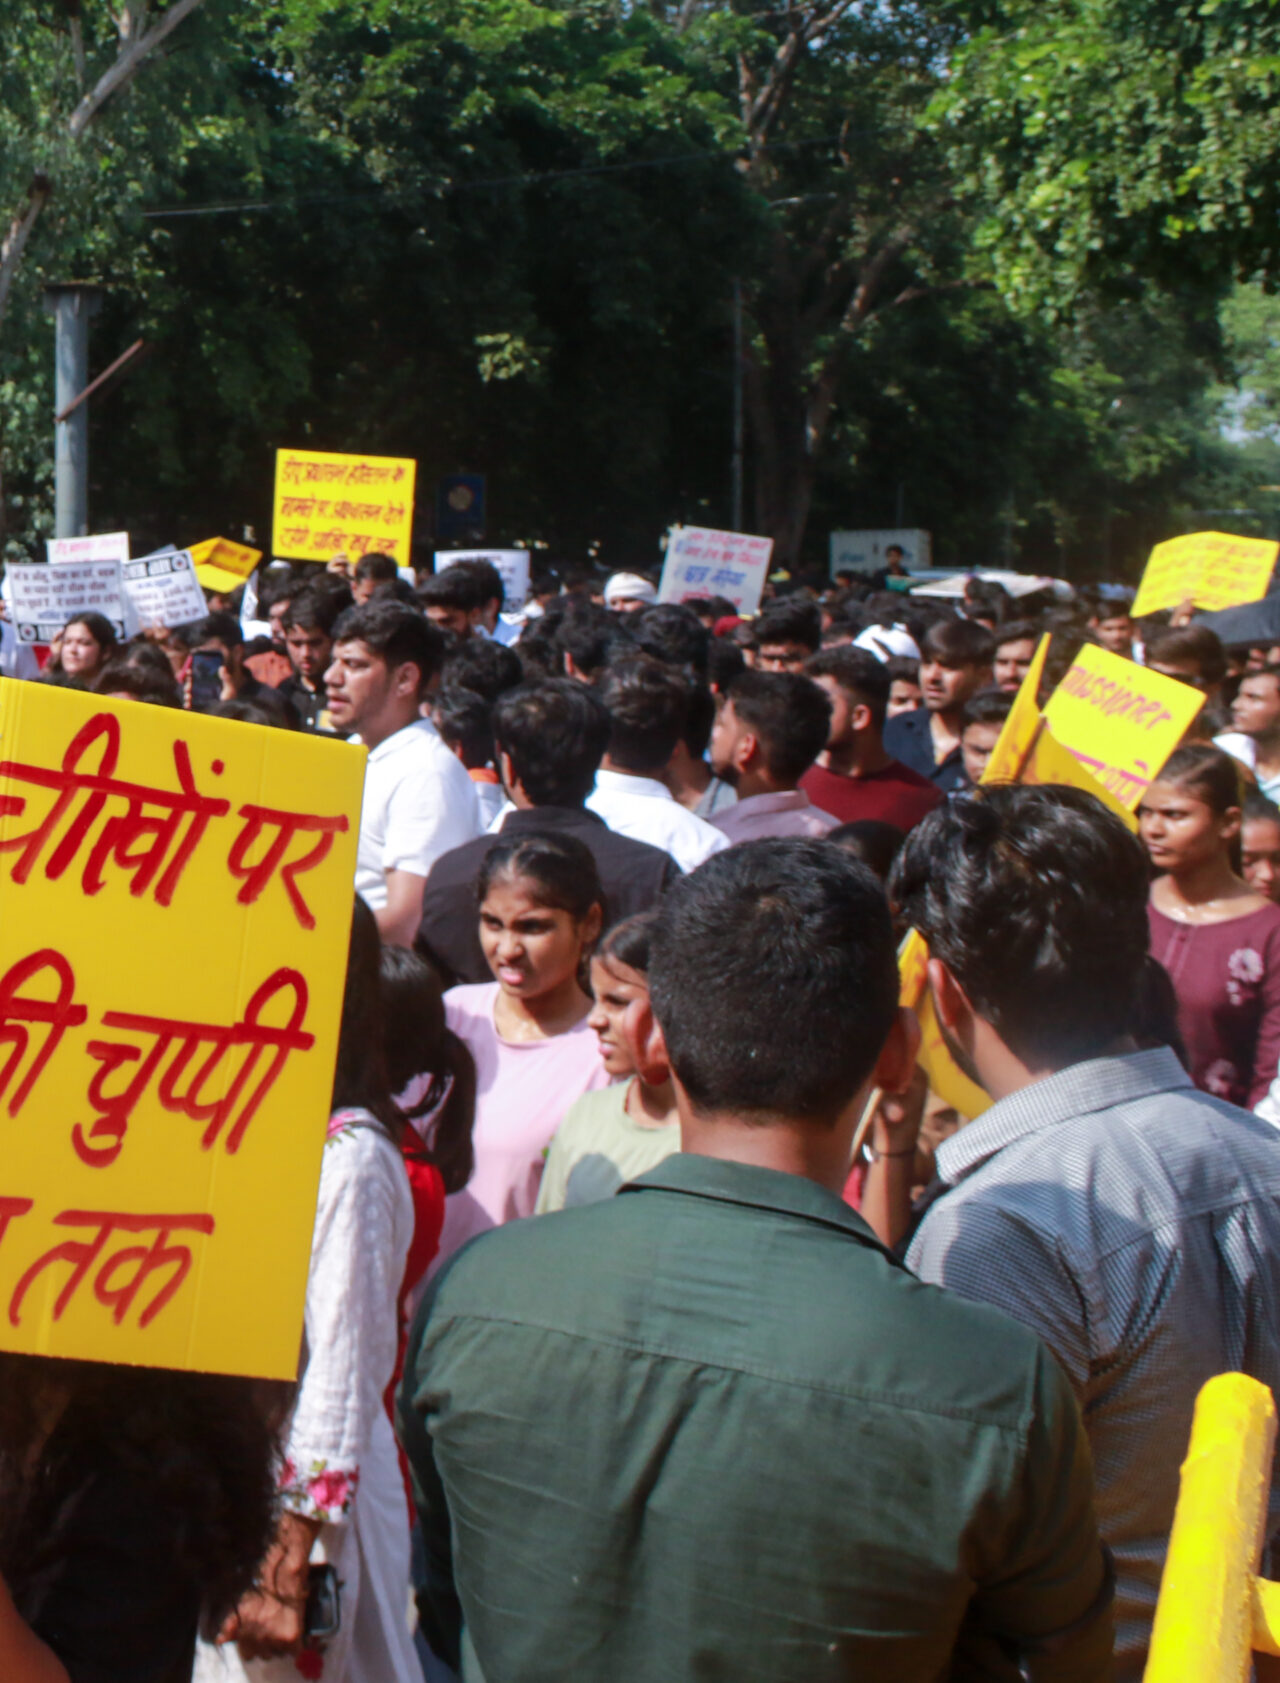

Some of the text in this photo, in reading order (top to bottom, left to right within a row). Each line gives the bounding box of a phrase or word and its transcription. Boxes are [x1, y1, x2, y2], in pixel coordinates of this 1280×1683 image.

[227, 804, 349, 930] पर
[71, 966, 315, 1168] चुप्पी
[8, 1209, 216, 1329] तक
